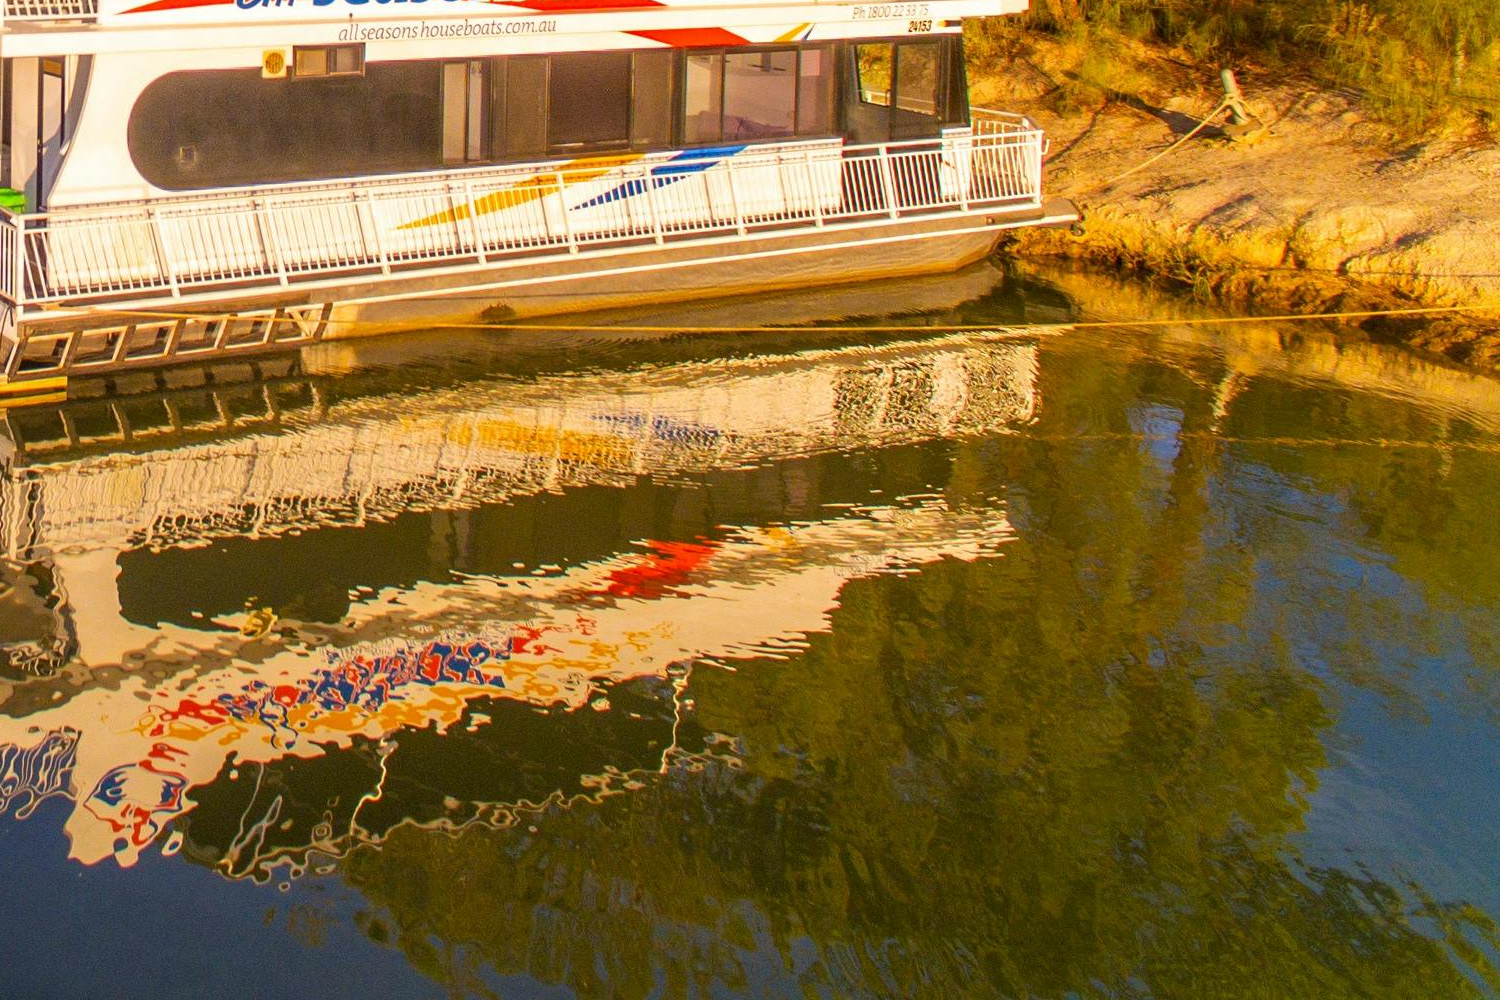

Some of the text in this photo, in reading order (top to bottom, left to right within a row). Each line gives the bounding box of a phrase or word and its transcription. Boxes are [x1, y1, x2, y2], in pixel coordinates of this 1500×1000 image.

[868, 5, 891, 19] 1800
[892, 4, 905, 17] 22
[908, 20, 933, 33] 24153
